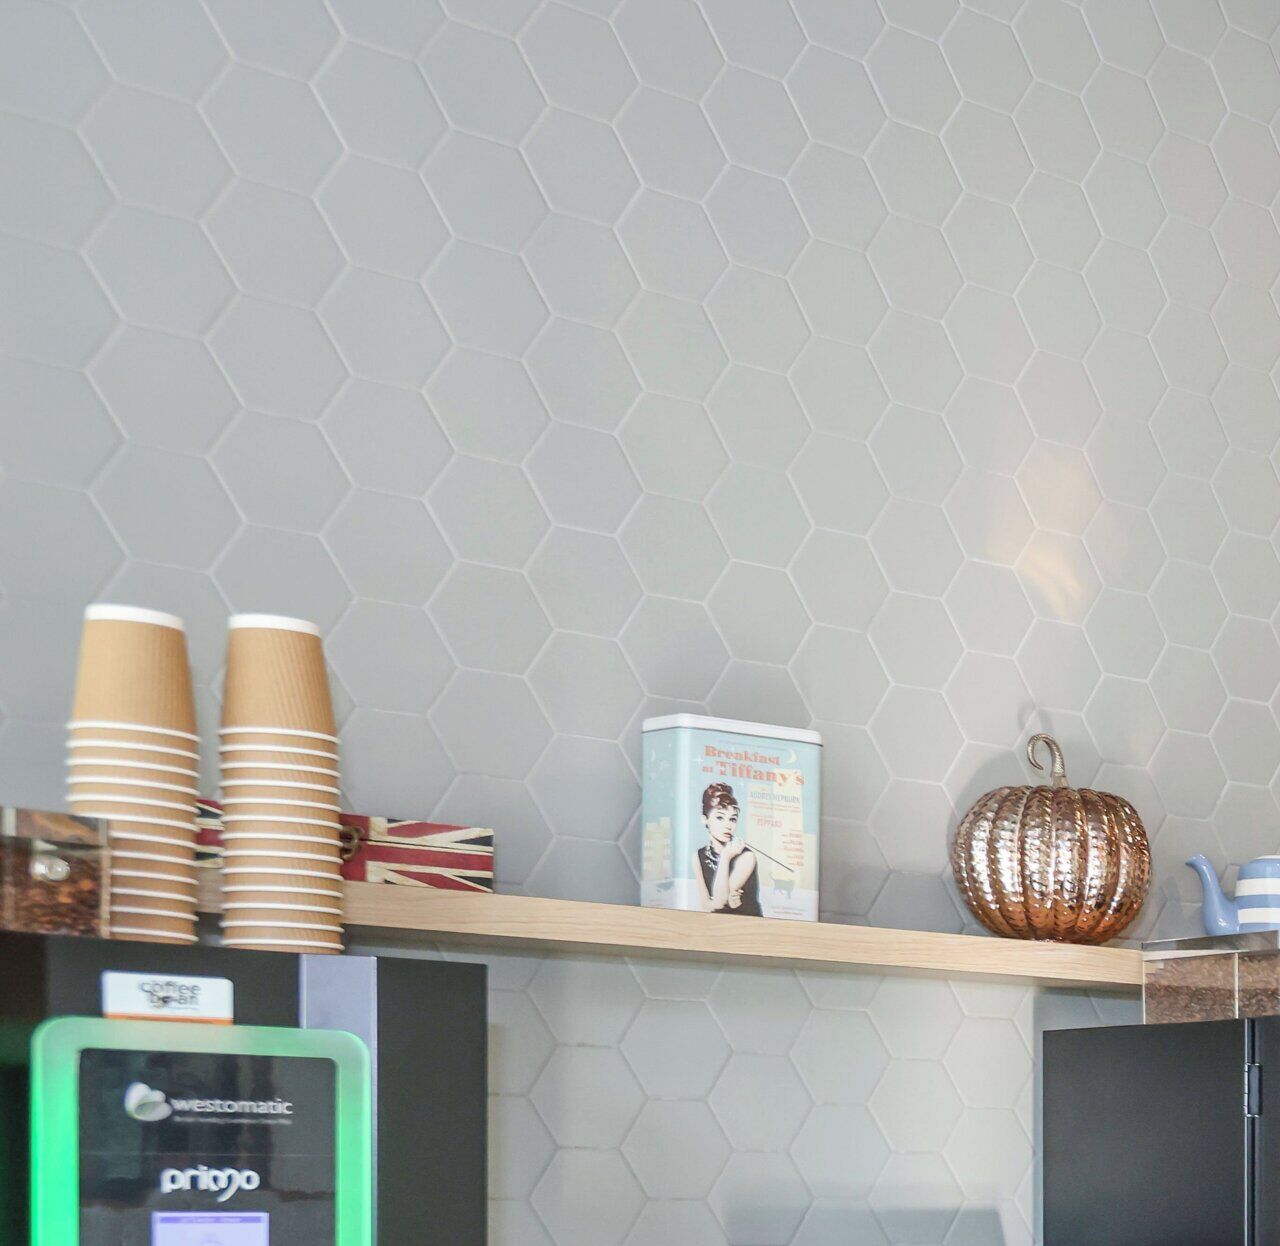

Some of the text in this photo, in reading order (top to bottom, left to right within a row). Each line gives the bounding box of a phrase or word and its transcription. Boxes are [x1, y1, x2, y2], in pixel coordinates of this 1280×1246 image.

[704, 745, 780, 766] Breakfast
[702, 760, 805, 786] at Tiffany's
[138, 980, 202, 996] coffee
[170, 1098, 294, 1115] westomatic
[160, 1164, 261, 1202] primo
